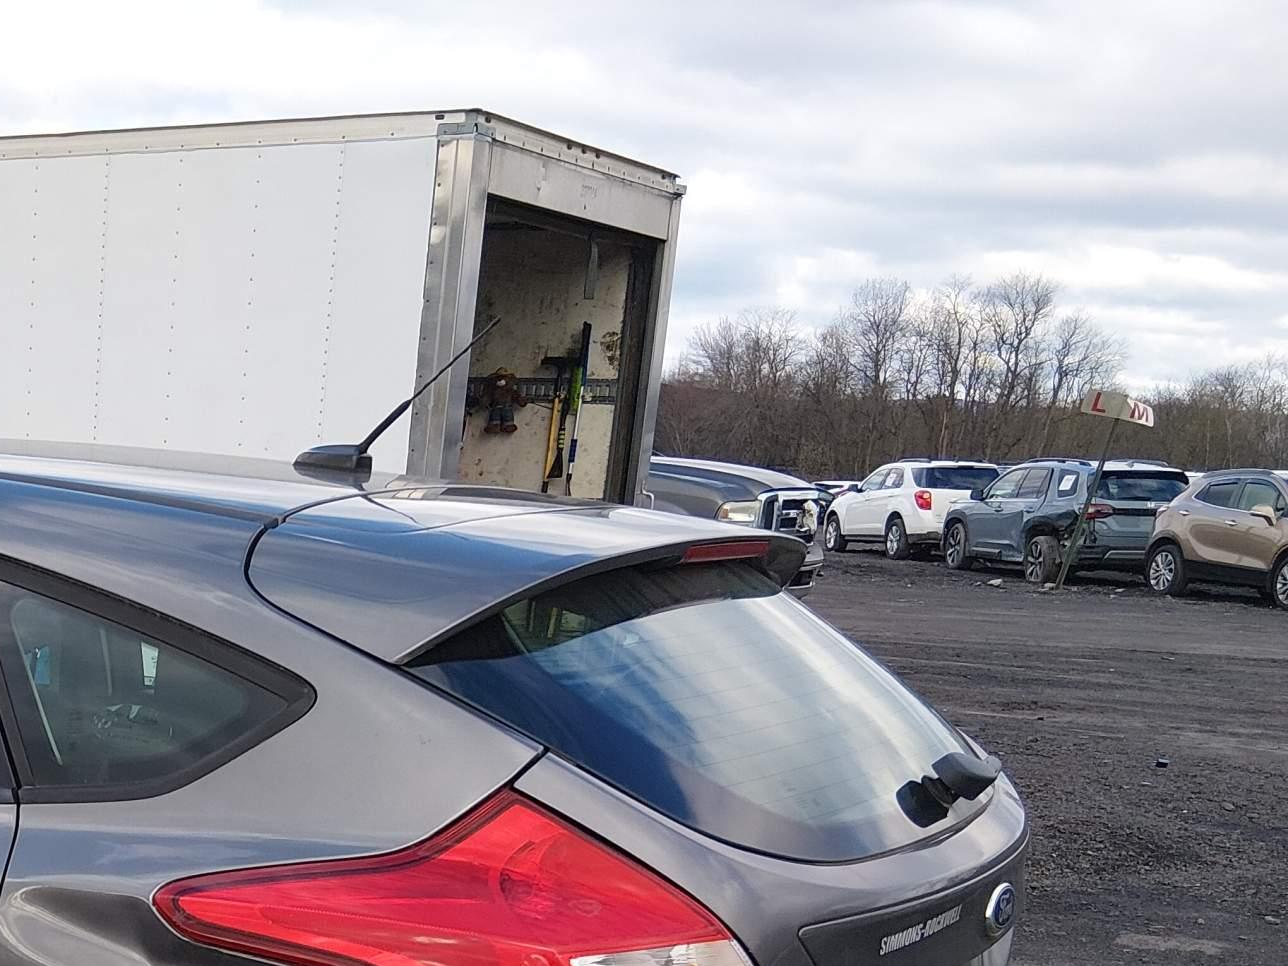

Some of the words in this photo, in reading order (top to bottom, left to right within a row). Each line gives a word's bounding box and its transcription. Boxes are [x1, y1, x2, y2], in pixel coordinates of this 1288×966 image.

[1091, 392, 1105, 413] L
[1130, 402, 1149, 422] M
[879, 904, 962, 956] SIMMONS-ROCKWELL
